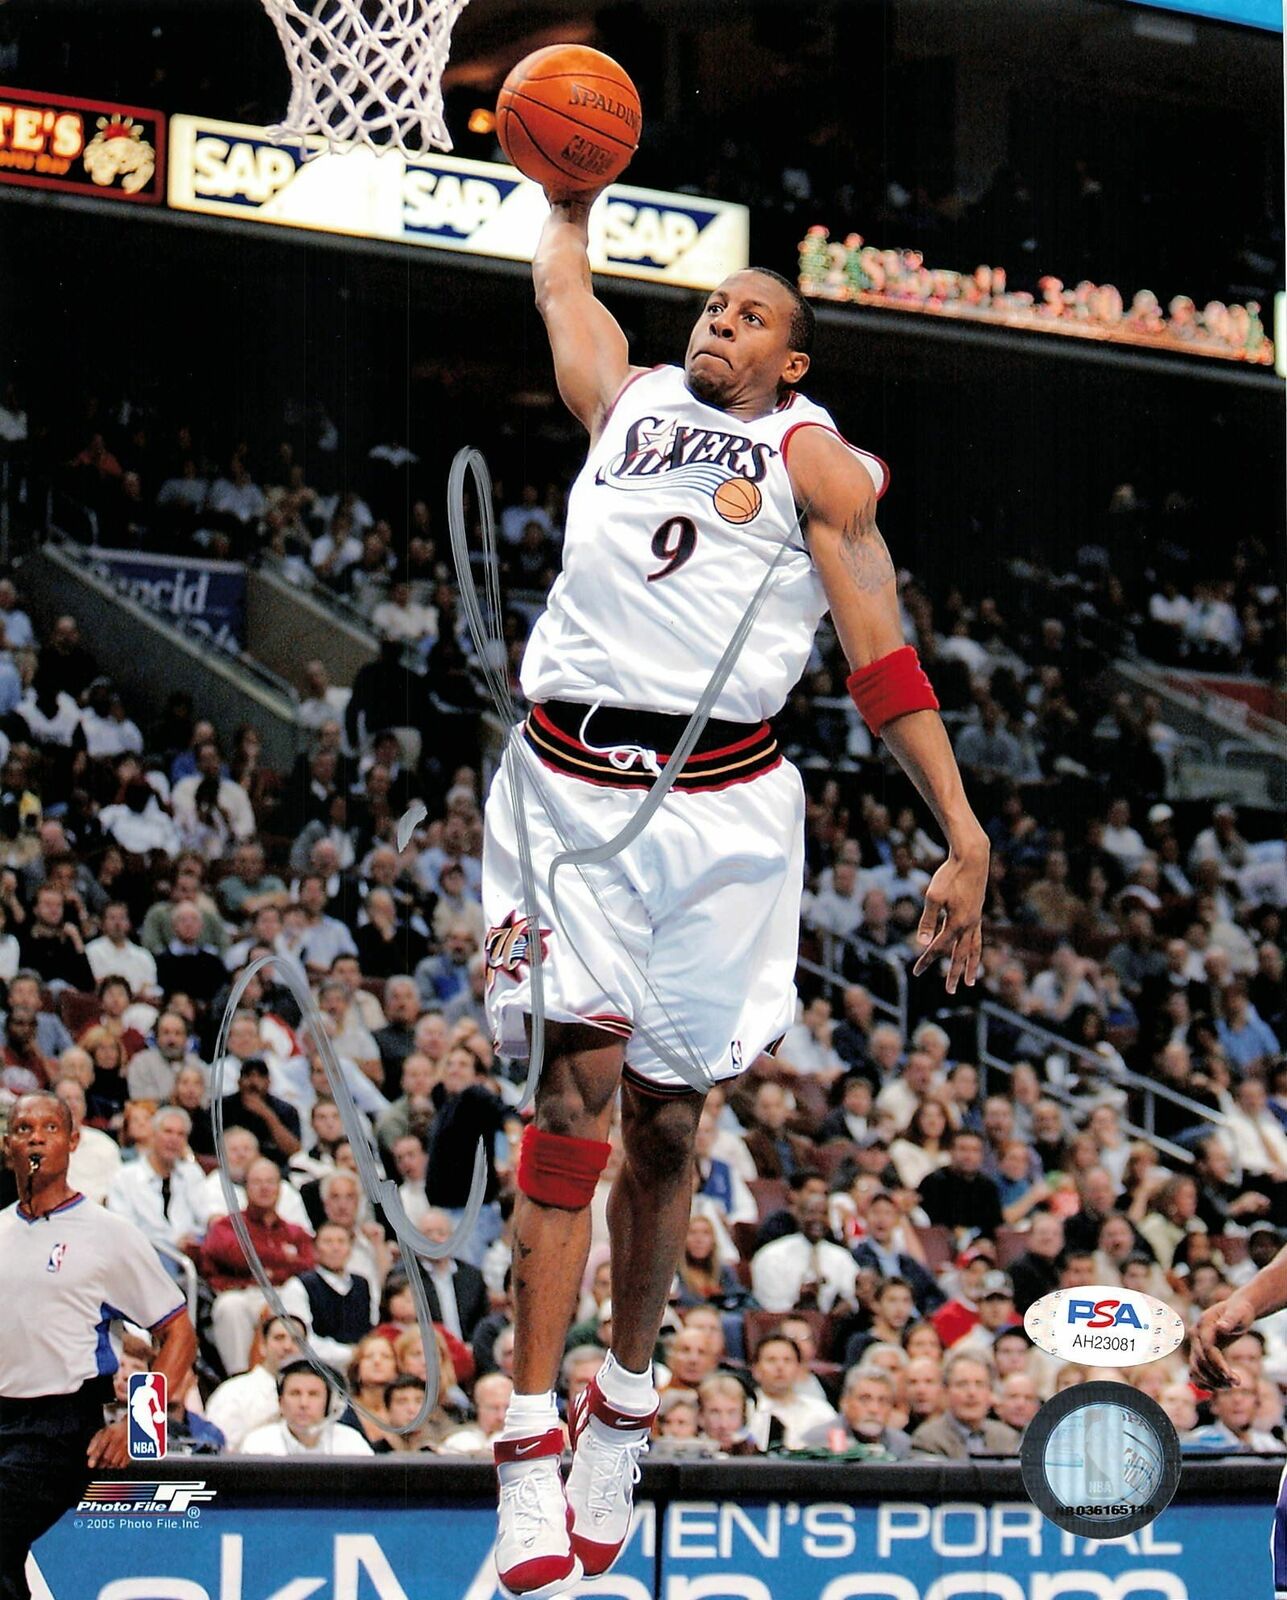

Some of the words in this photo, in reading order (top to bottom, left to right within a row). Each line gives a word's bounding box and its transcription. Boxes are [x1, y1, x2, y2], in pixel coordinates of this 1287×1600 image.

[195, 137, 296, 202] SAP
[404, 169, 500, 234] SAP
[605, 201, 700, 264] SAP
[646, 515, 698, 583] 9
